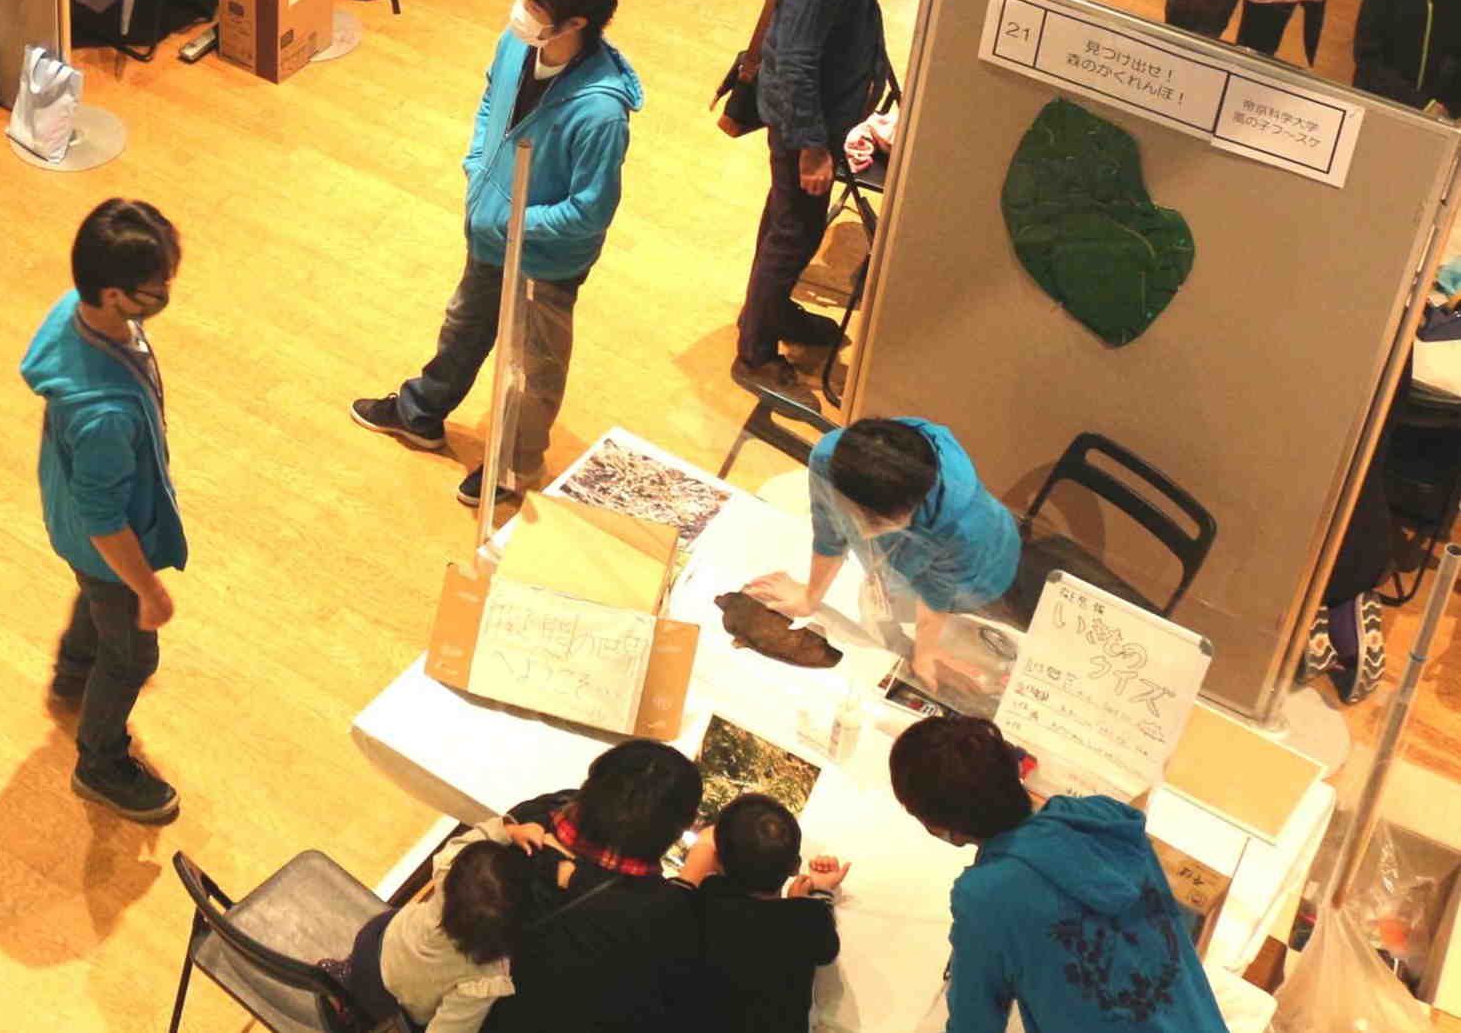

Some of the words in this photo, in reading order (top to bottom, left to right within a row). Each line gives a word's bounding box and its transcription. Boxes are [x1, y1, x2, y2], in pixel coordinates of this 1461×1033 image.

[1005, 22, 1030, 42] 21
[1084, 40, 1174, 83] 見つけ出せ！
